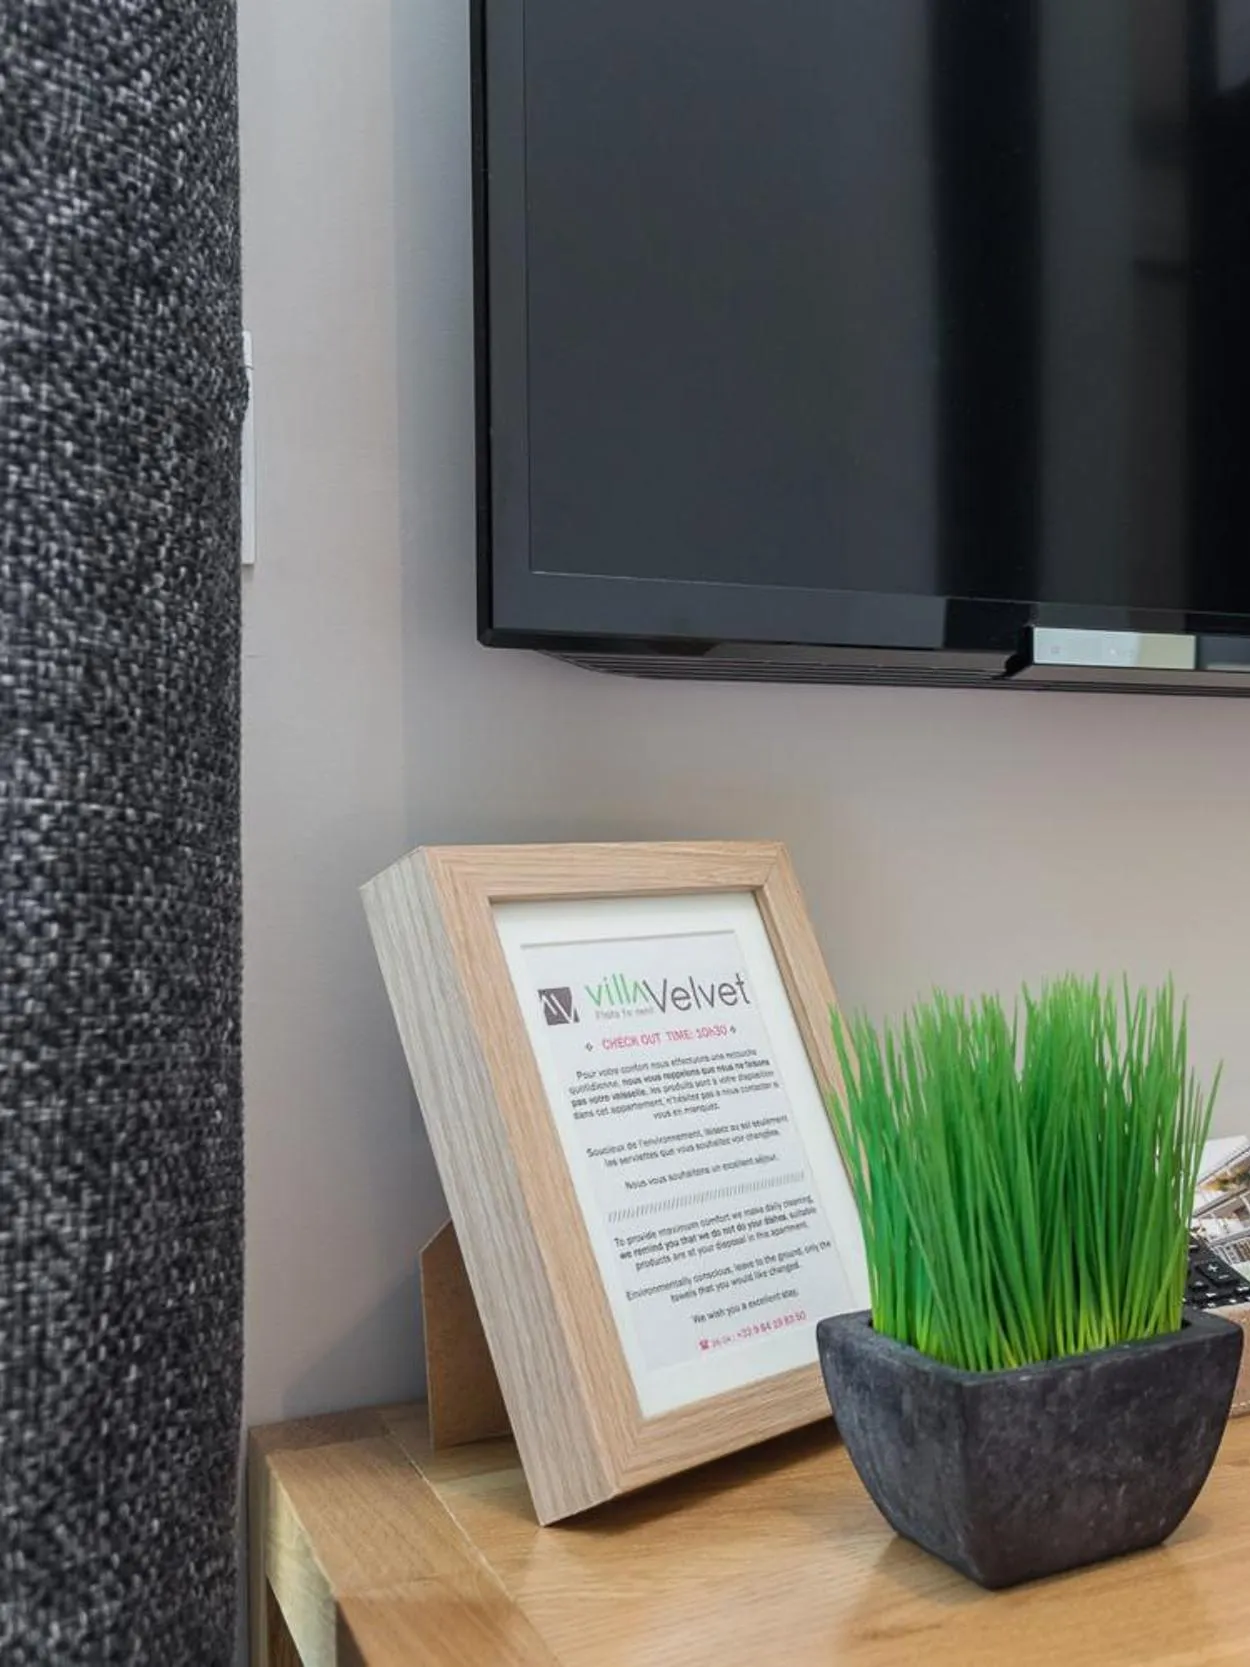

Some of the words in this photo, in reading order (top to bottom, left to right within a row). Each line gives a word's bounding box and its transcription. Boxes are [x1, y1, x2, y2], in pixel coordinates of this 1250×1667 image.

[602, 1036, 639, 1050] CHECK
[640, 1032, 661, 1045] OUT
[576, 1071, 597, 1080] Pour
[624, 1180, 648, 1189] Nous
[647, 1176, 667, 1185] vous
[664, 1240, 680, 1251] you
[680, 1234, 697, 1245] that
[722, 1225, 736, 1234] not
[715, 1281, 730, 1292] you
